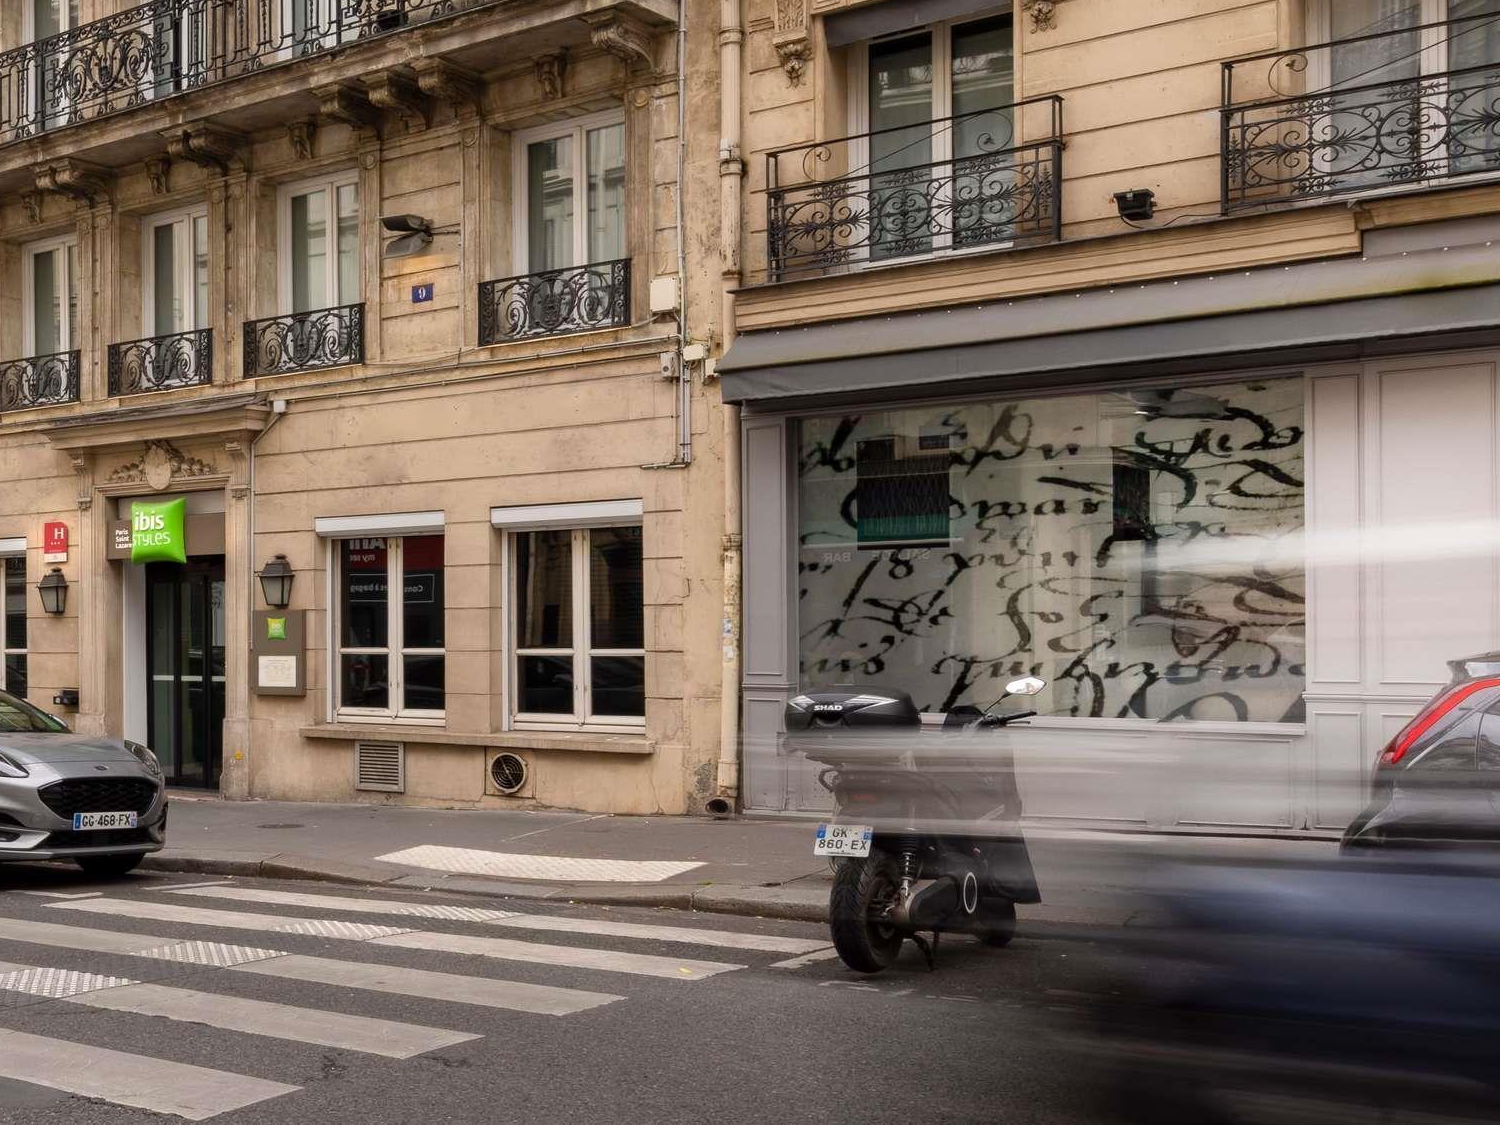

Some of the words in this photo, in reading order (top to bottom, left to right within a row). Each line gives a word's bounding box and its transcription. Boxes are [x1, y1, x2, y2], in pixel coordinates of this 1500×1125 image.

[418, 286, 426, 300] 9
[135, 511, 164, 531] ibis
[54, 527, 64, 540] H
[82, 814, 131, 827] GG-468-FX
[818, 838, 868, 851] 860-EX
